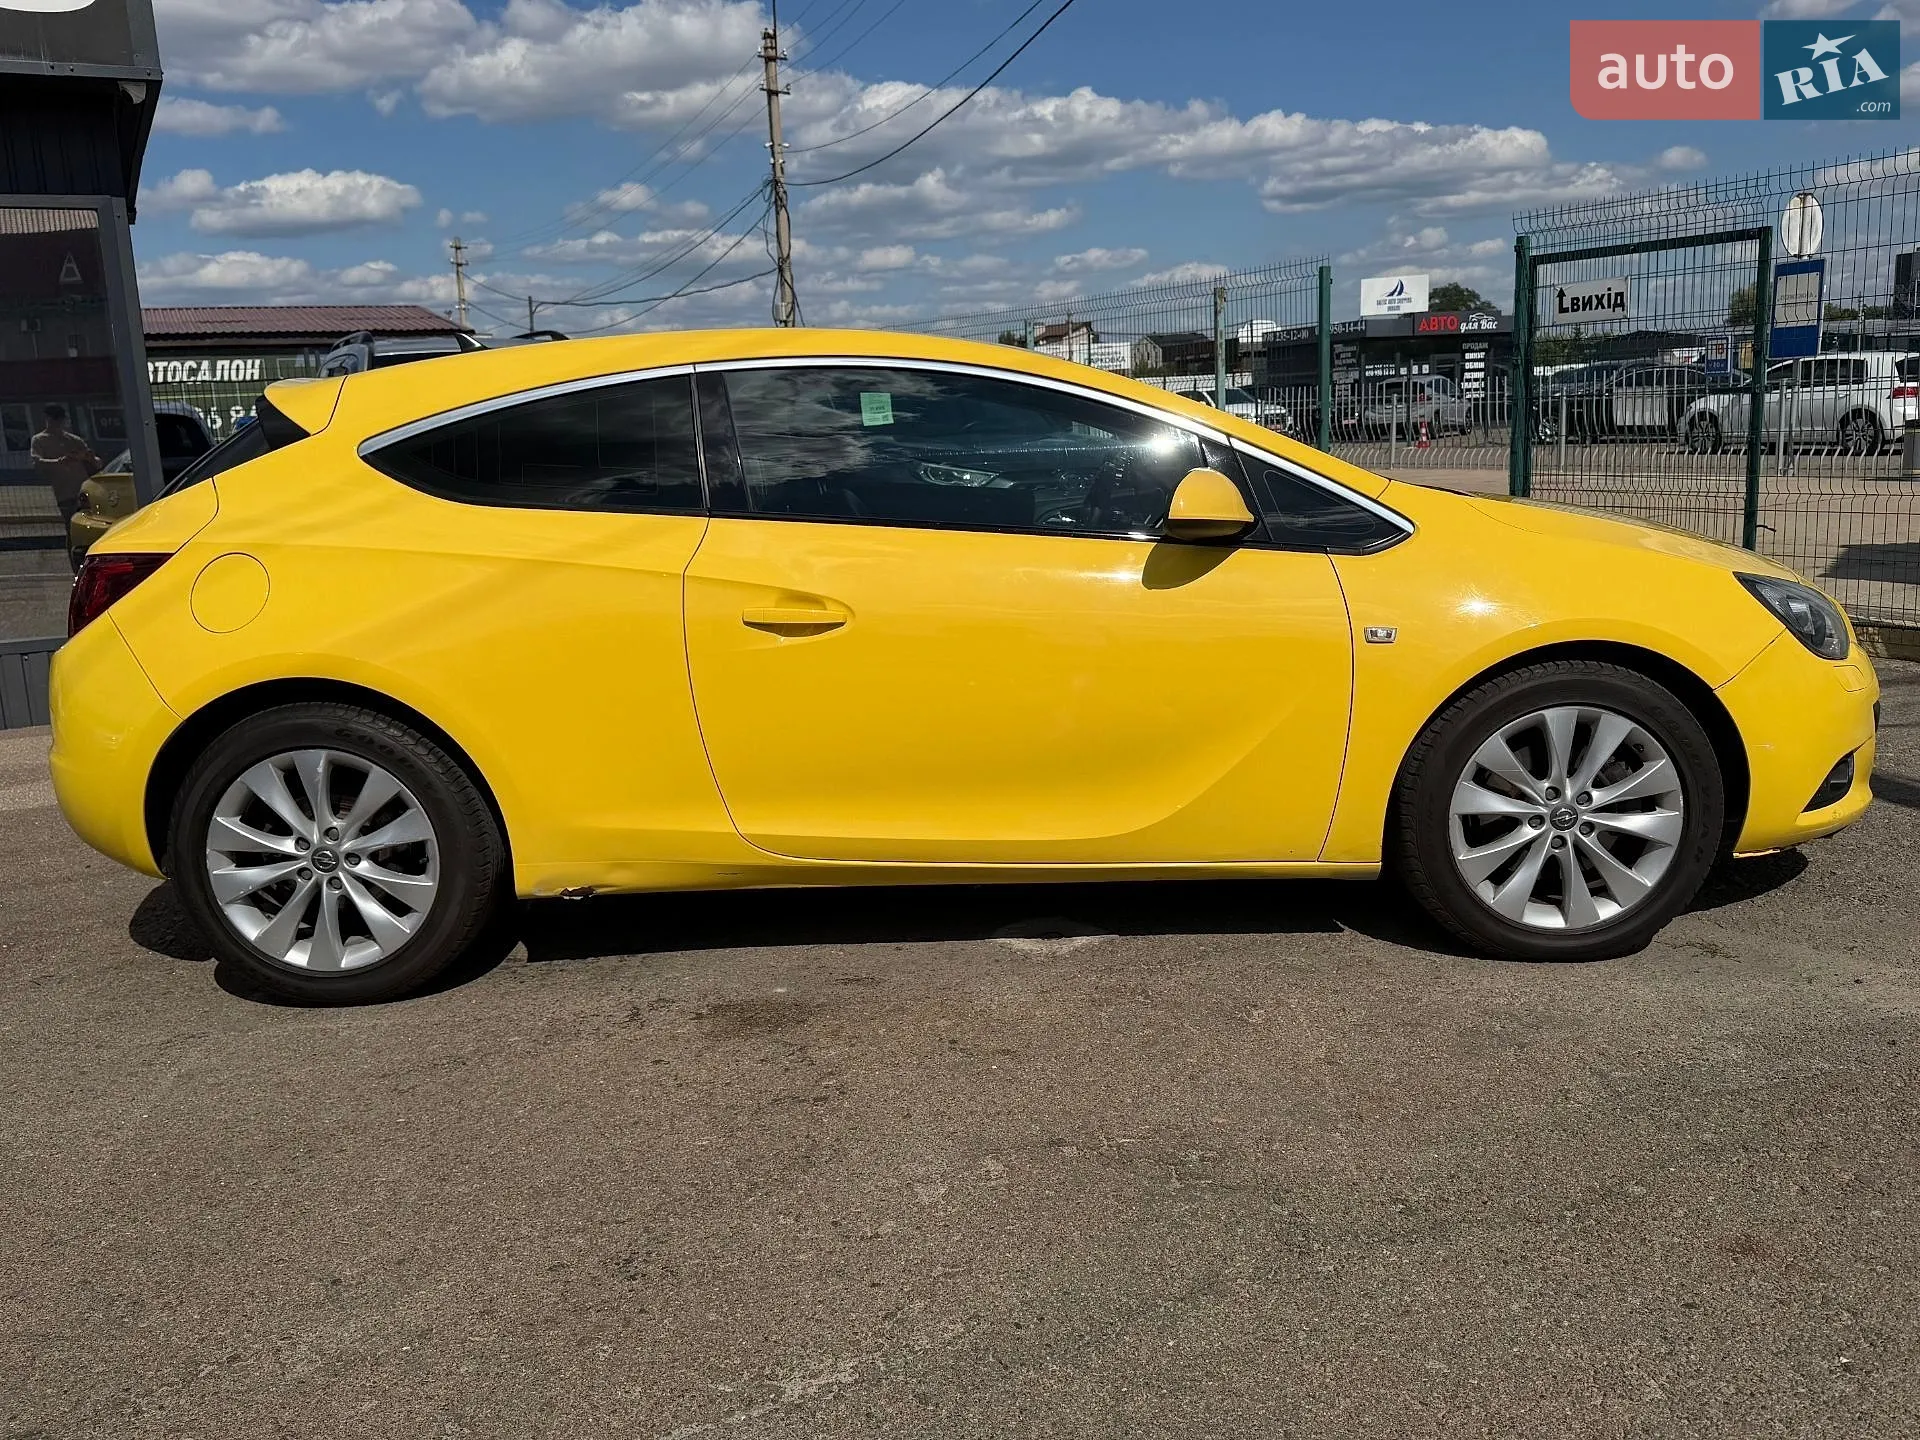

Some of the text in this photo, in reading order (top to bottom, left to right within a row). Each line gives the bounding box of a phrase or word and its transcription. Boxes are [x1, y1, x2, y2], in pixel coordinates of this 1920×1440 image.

[1570, 287, 1625, 312] вихід
[1418, 316, 1499, 334] АВТО для Вас
[1462, 342, 1489, 351] ПРОДАЖ
